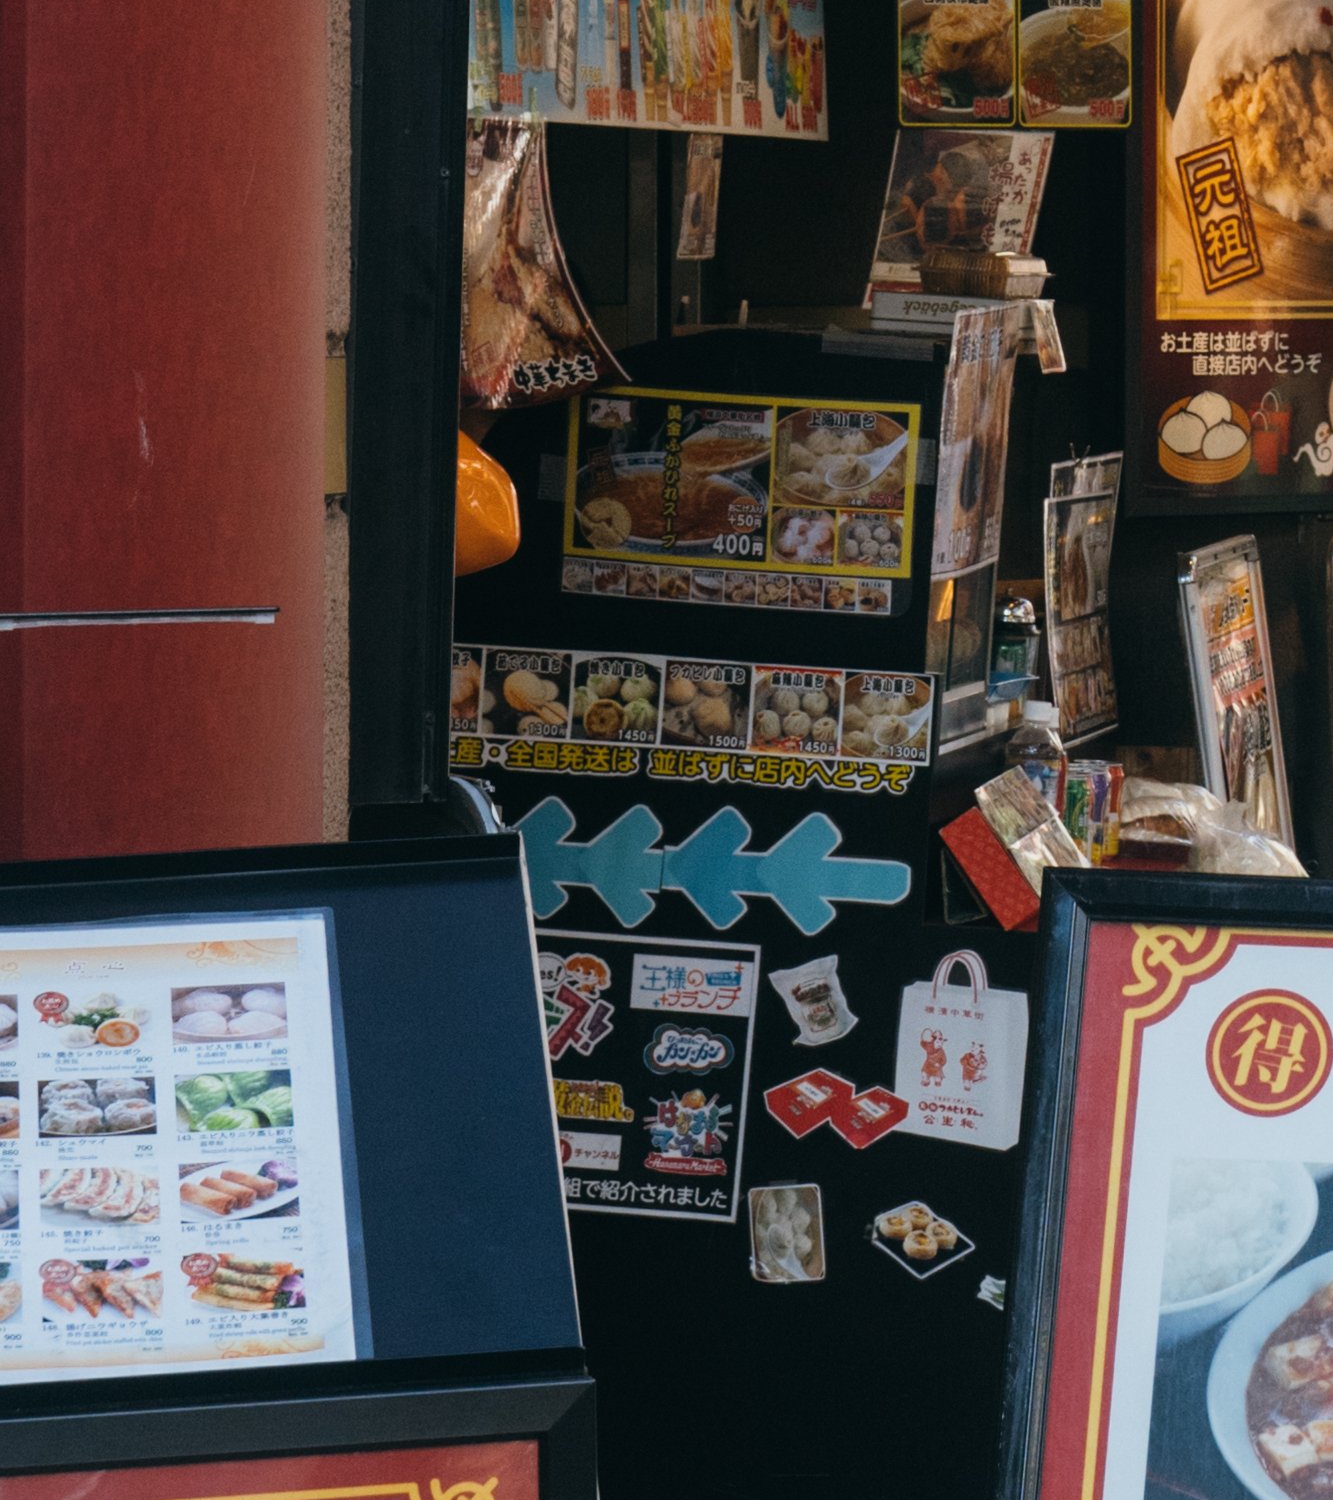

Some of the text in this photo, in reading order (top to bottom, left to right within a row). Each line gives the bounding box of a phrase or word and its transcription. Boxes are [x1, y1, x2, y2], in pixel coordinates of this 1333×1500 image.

[1159, 331, 1291, 355] お土産は並ばずに
[1191, 354, 1323, 377] 直接店内へどうぞ
[650, 749, 915, 794] 並ばずに店内へどうぞ
[1233, 1014, 1308, 1096] 得
